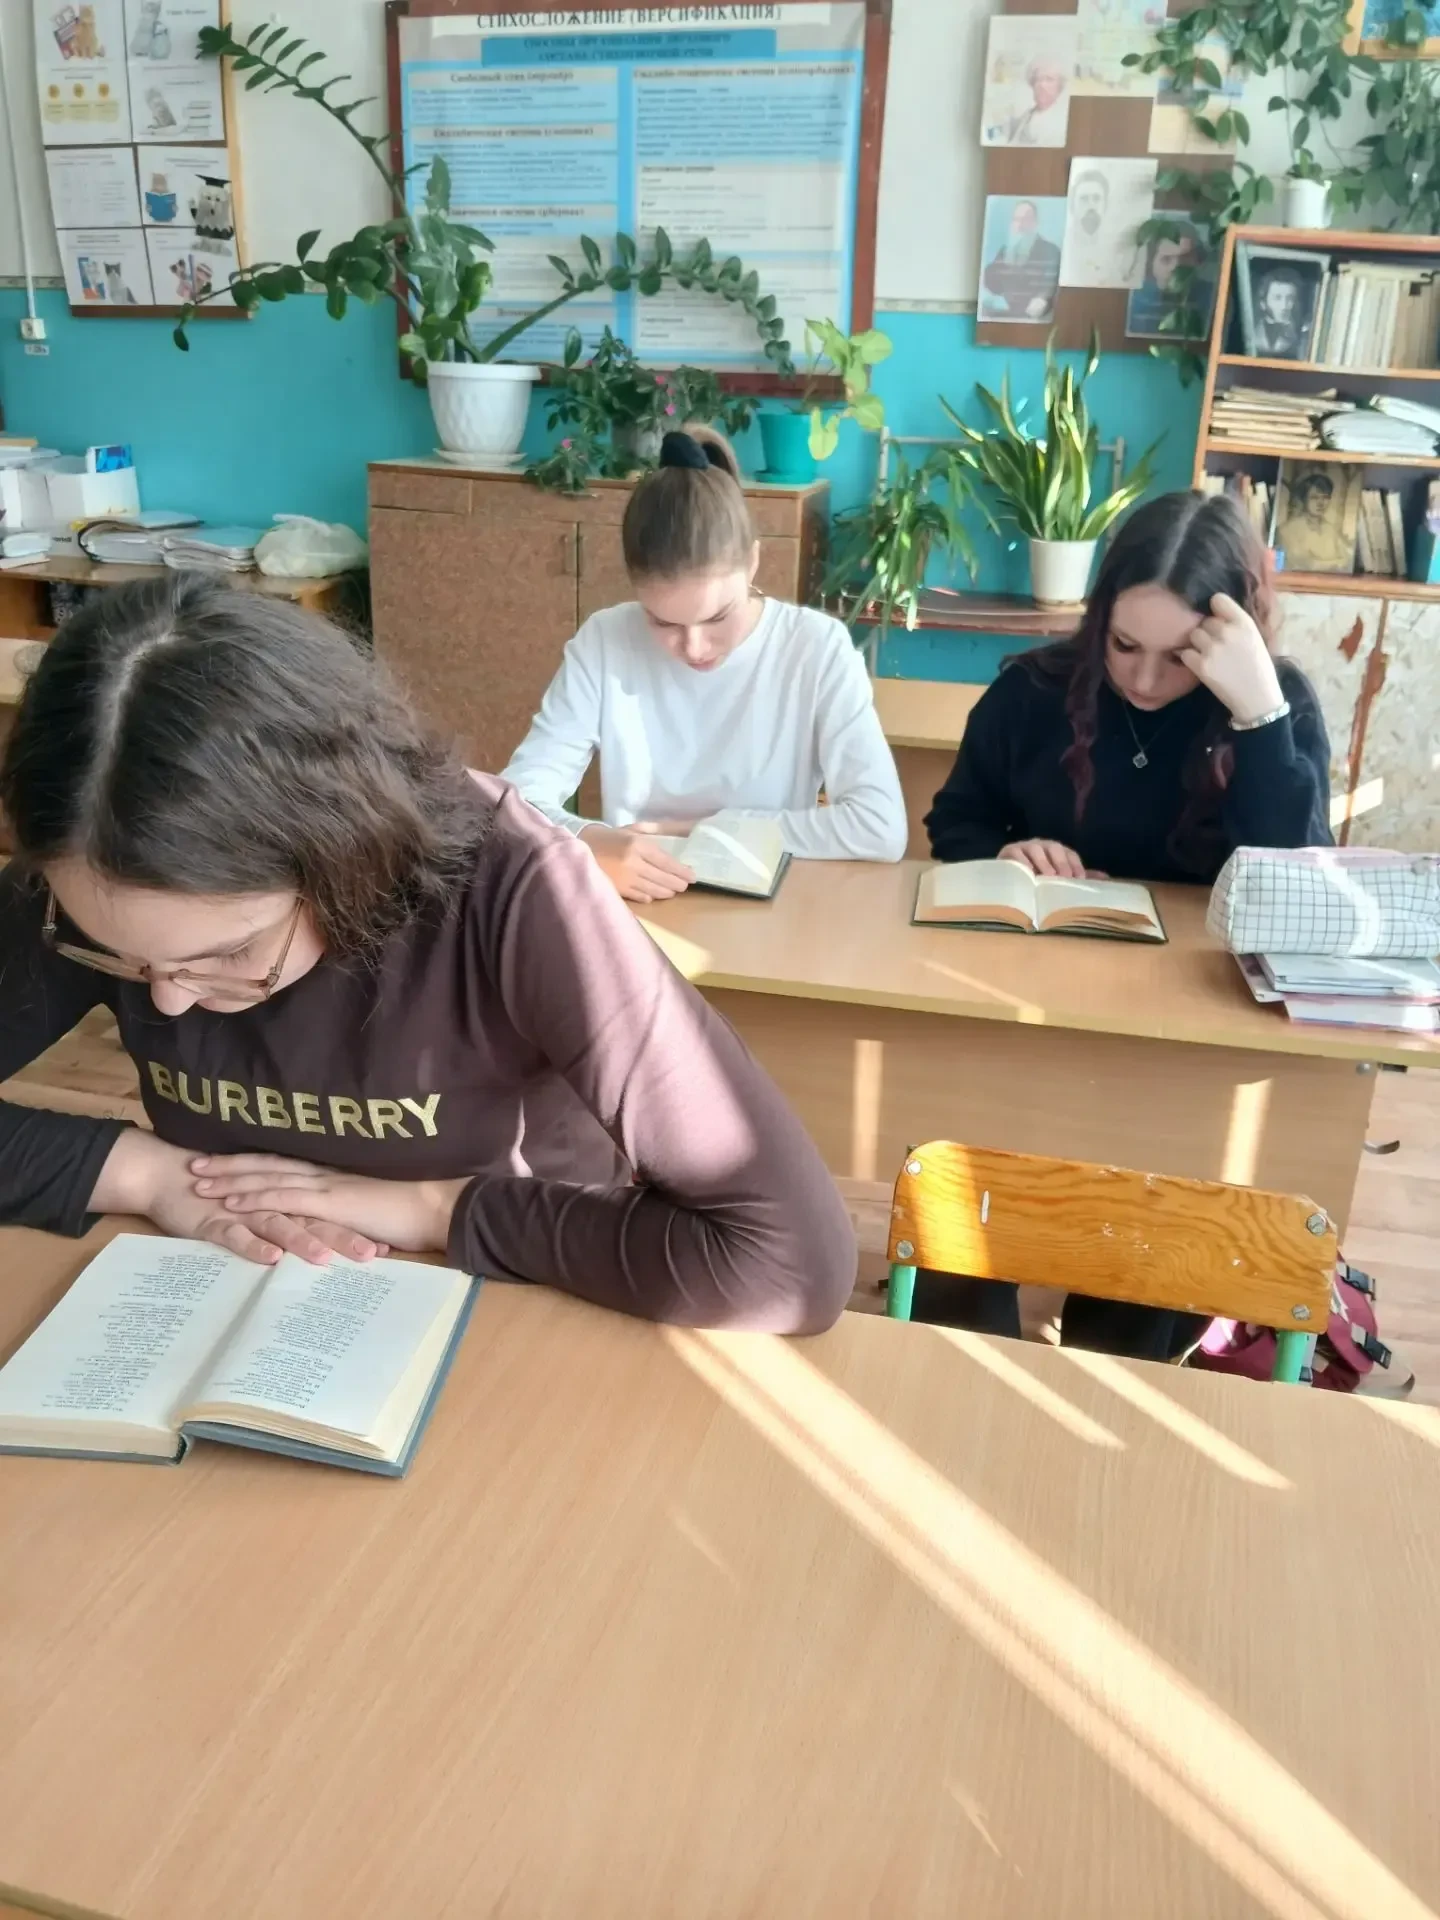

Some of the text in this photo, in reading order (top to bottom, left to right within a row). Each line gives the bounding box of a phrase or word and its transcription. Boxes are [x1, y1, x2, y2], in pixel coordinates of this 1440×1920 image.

[476, 4, 782, 29] СТИХОСЛОЖЕНИЕ (ВЕРСИФИКАЦИЯ)
[148, 1061, 441, 1139] BURBERRY
